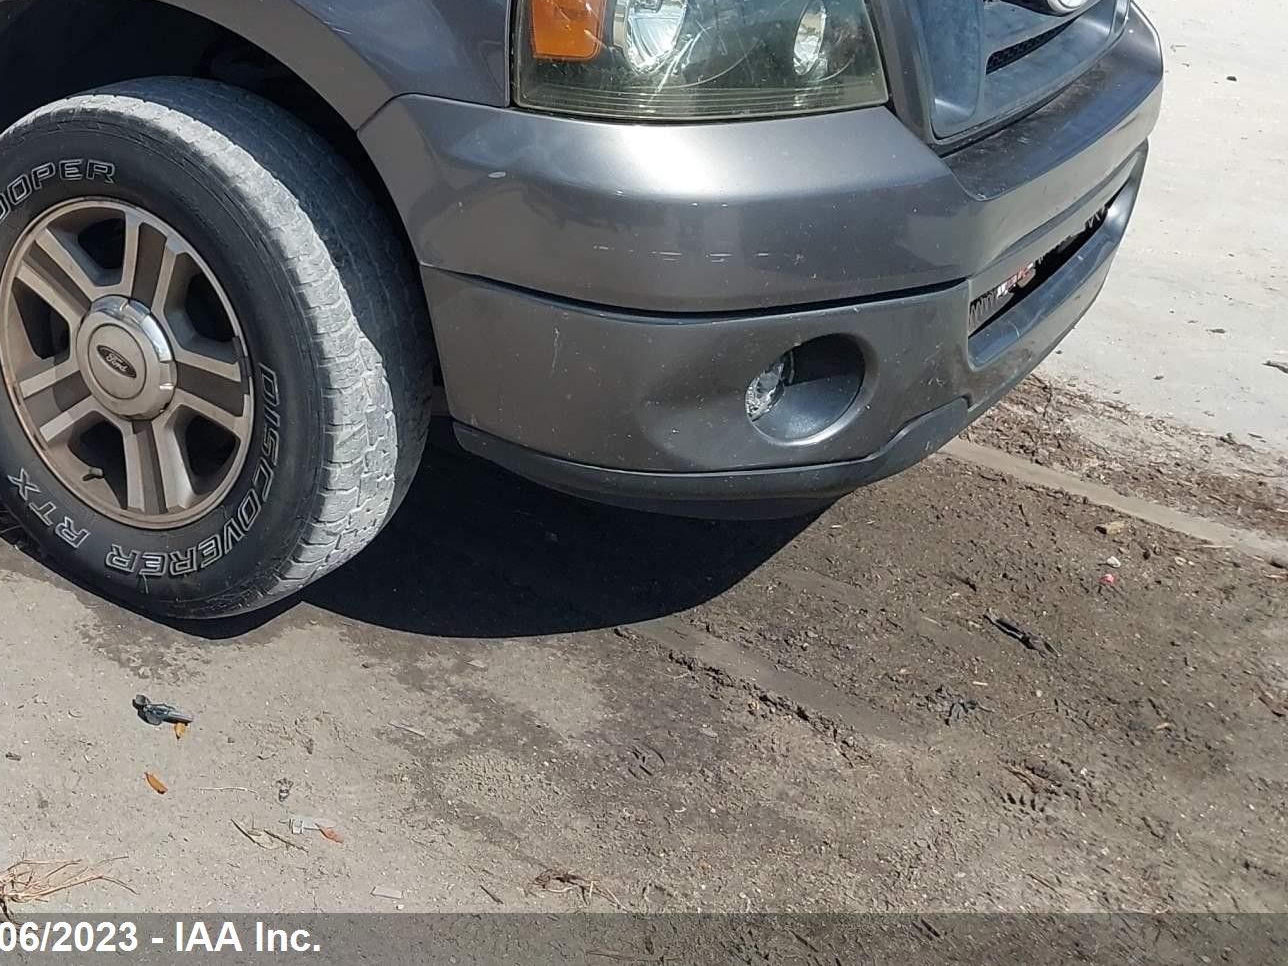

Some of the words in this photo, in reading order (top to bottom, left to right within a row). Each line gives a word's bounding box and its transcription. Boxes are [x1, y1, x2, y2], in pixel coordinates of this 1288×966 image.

[105, 351, 130, 372] Ford
[8, 468, 90, 550] RTX
[105, 363, 281, 577] DISCOVERER
